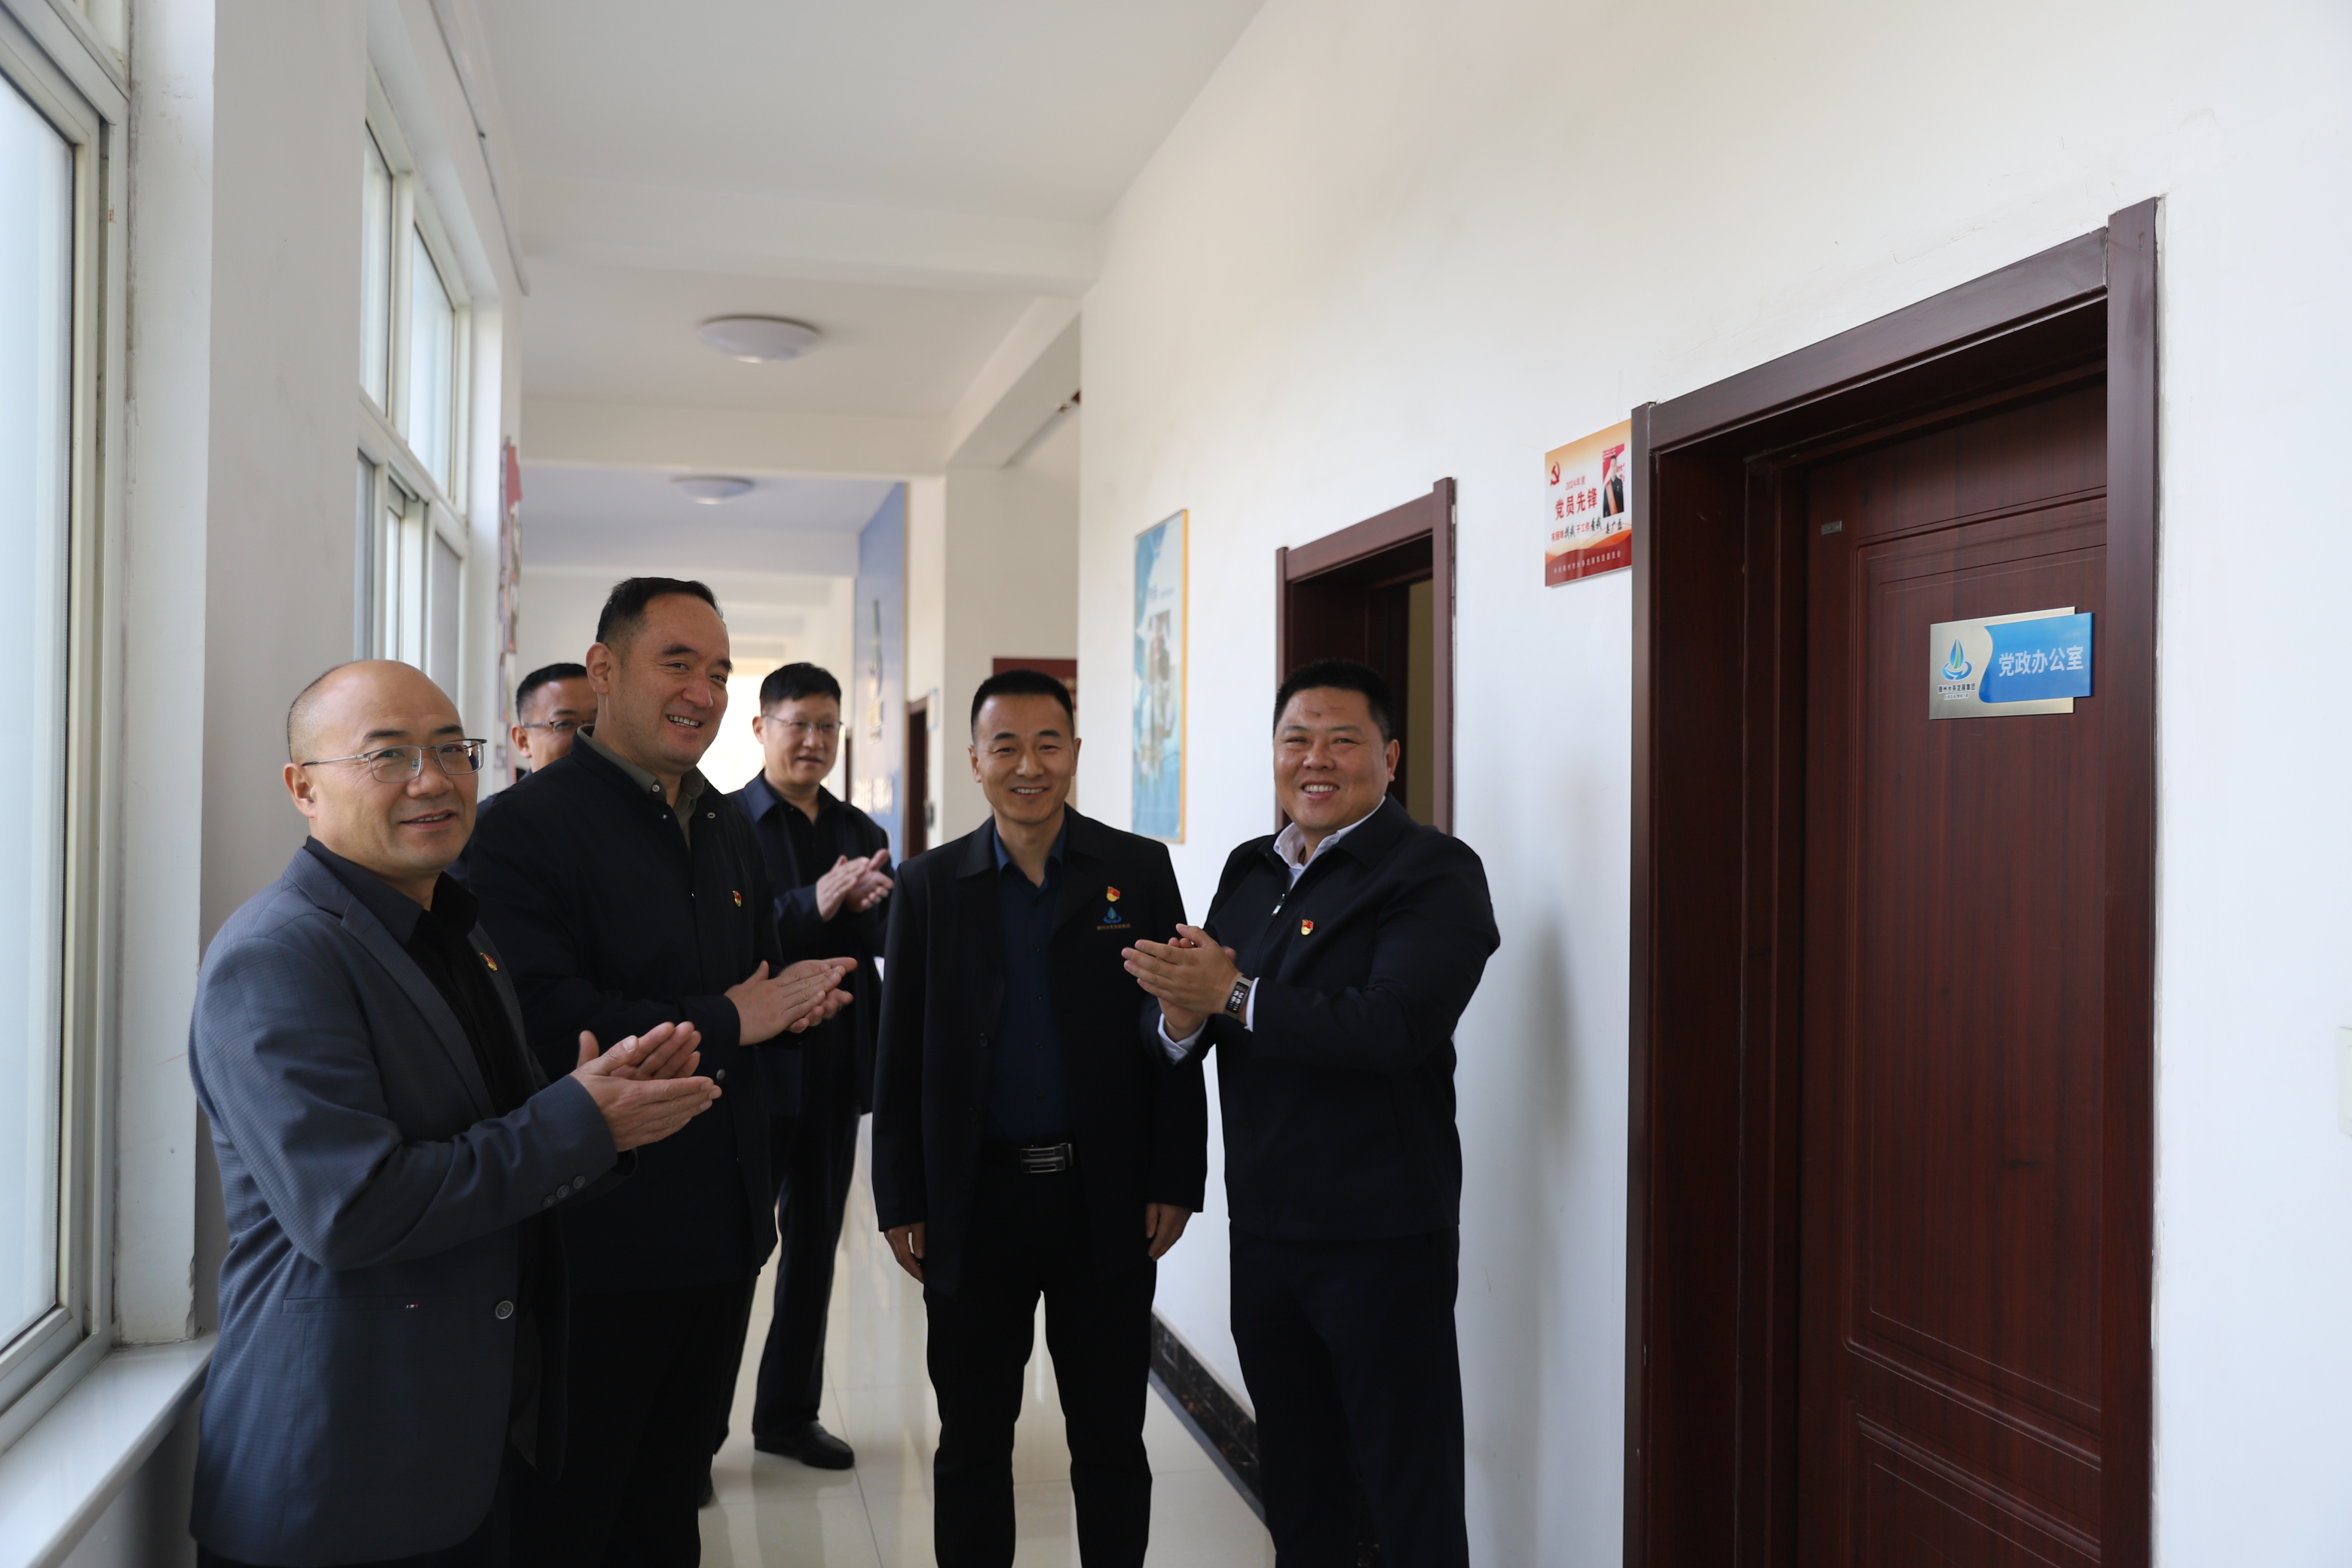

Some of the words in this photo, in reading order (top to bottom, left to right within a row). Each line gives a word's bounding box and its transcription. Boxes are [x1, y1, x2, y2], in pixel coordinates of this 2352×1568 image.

[1555, 488, 1597, 520] 党员先锋
[1998, 645, 2084, 677] 党政办公室
